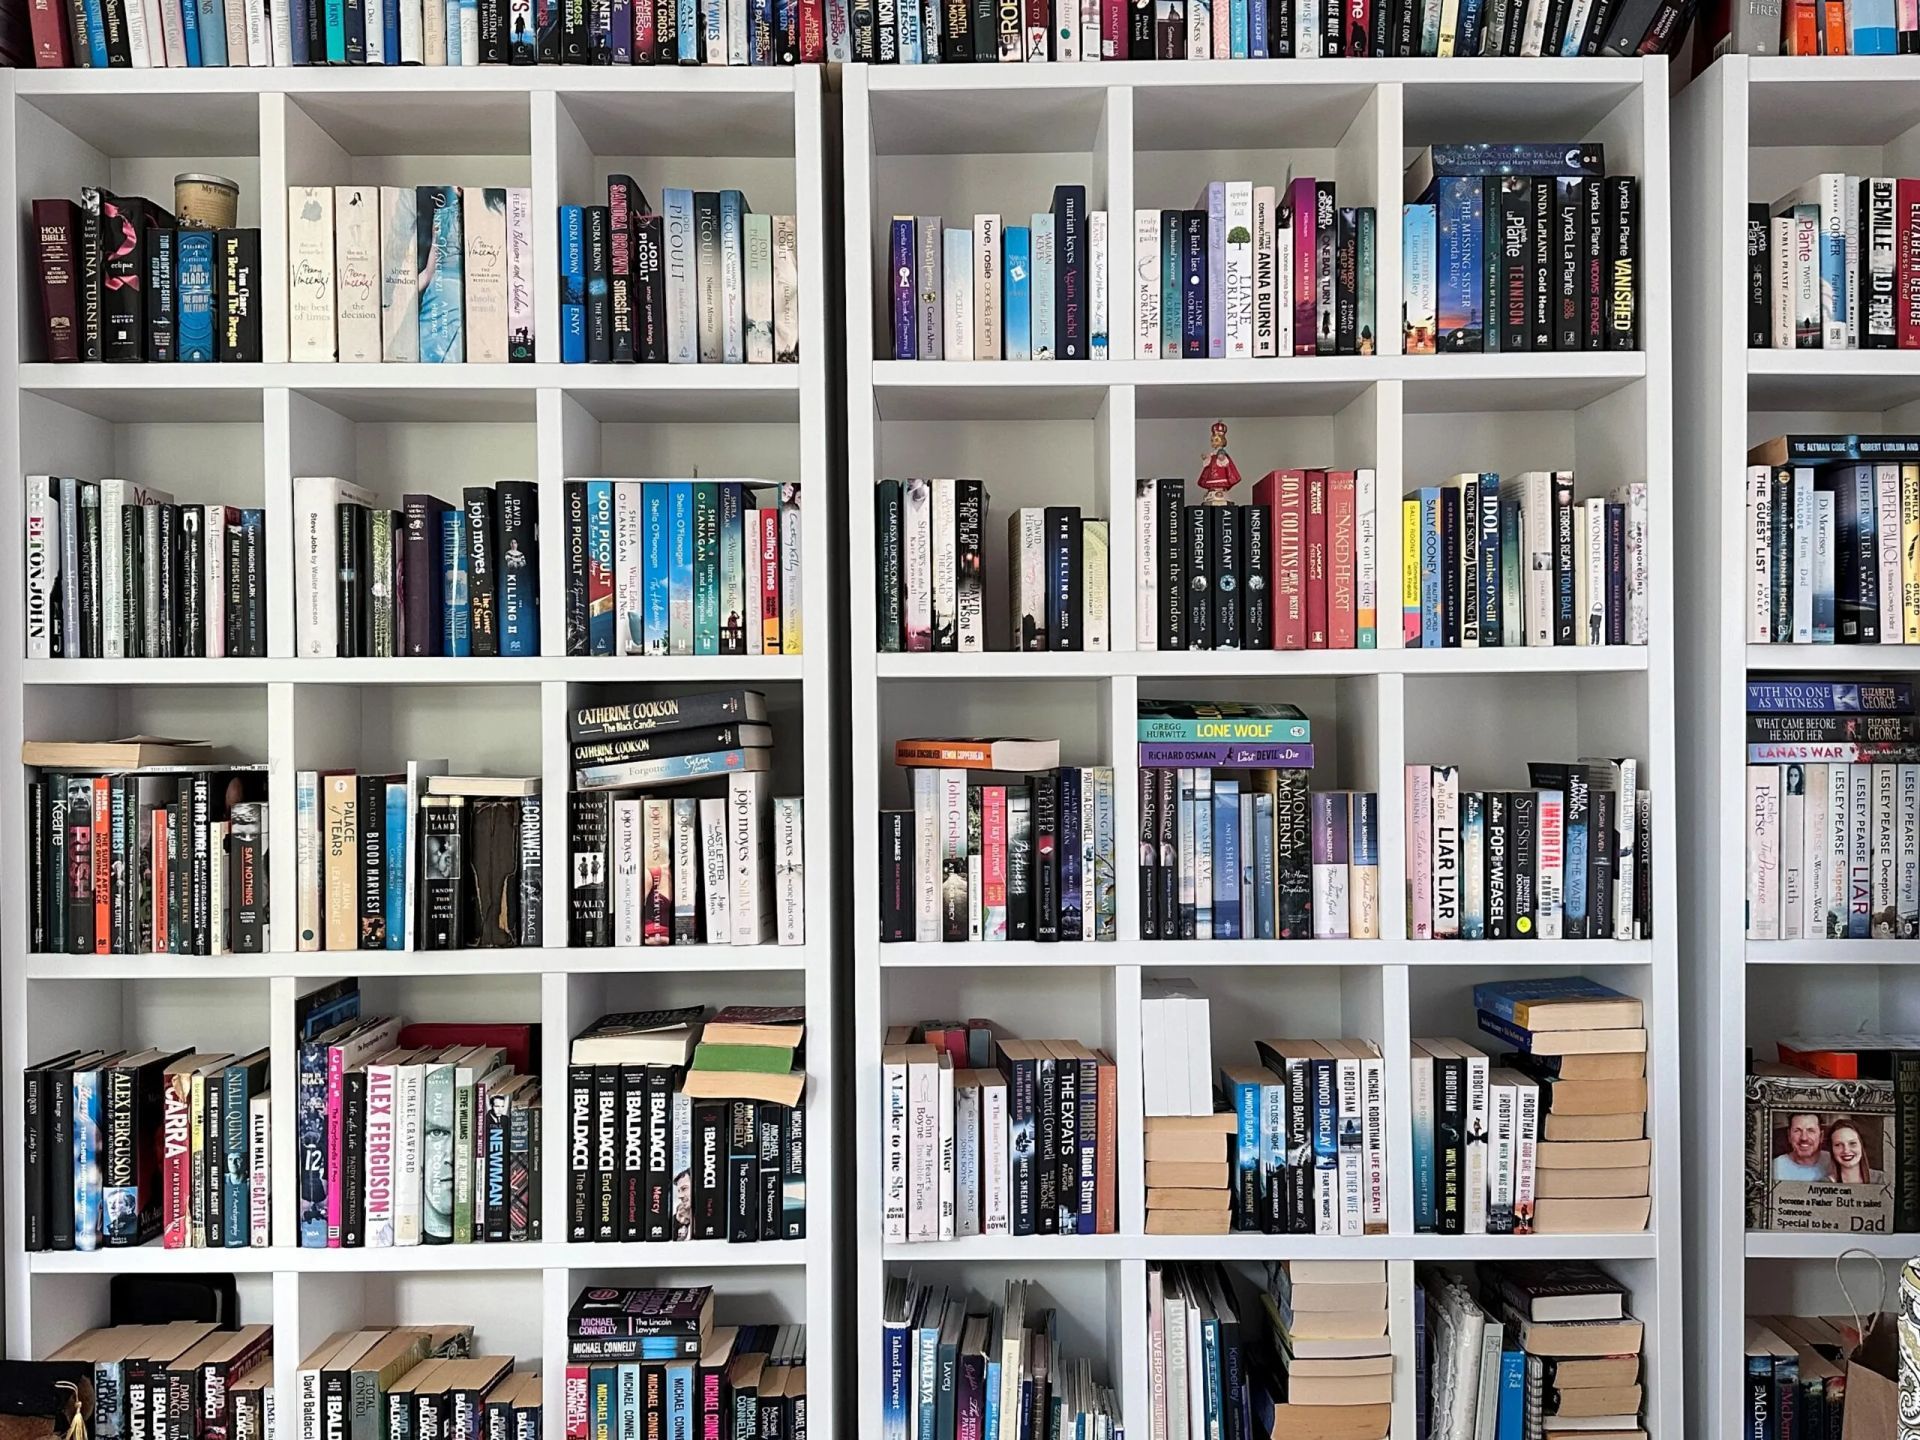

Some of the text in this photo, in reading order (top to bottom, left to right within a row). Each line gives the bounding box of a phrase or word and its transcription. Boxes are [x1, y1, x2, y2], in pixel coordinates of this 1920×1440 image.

[658, 18, 667, 43] CROSS
[709, 15, 719, 40] WIVES
[951, 7, 959, 38] MONTH
[1654, 6, 1671, 34] DOWNING
[1659, 9, 1679, 39] SAMANTHA
[1750, 4, 1779, 17] FIRES
[754, 11, 763, 61] PATTERSON
[762, 21, 770, 49] JAMES
[862, 26, 872, 57] PRIVATE
[41, 226, 66, 234] HOLY
[41, 234, 66, 242] BIBLE
[670, 205, 684, 281] PICOULT
[1799, 220, 1812, 262] Plante
[1874, 189, 1892, 251] DEMILLE
[639, 233, 648, 281] PICOULT
[649, 242, 657, 271] JODI
[1258, 253, 1270, 288] ANNA
[1614, 181, 1632, 331] Lynda La Plante VANISHED
[86, 241, 96, 341] TINA TURNER
[386, 275, 416, 285] abandon
[1227, 262, 1238, 339] MORIARTY
[1240, 276, 1251, 325] LIANE
[1510, 265, 1523, 325] TENNISON
[294, 303, 329, 311] the best
[342, 310, 376, 319] decision
[571, 308, 579, 335] ENVY
[1259, 294, 1271, 336] BURNS
[513, 499, 521, 526] DAVID
[571, 492, 582, 575] JODI PICOULT
[1281, 475, 1299, 567] JOAN COLLINS
[1756, 474, 1765, 574] THE GUEST LIST
[469, 501, 485, 574] jojo moyes
[599, 491, 610, 587] JODI PICOULT
[1194, 510, 1203, 570] DIVERGENT
[1222, 510, 1231, 569] ALLEGIANT
[1251, 510, 1260, 569] INSURGENT
[1426, 500, 1436, 574] SALLY ROONEY
[1467, 486, 1475, 622] PROPHET SONG PAUL LYNCH
[30, 517, 45, 638] ELTON JOHN
[970, 584, 979, 615] DAVID
[961, 592, 970, 630] HEWSON
[578, 700, 679, 726] CATHERINE COOKSON
[1750, 687, 1830, 698] WITH NO ONE
[1197, 725, 1231, 737] LONE
[1234, 725, 1273, 737] WOLF
[53, 800, 66, 846] Keane
[113, 789, 124, 854] AFTER EVEREST
[344, 801, 355, 843] PALACE
[429, 813, 457, 822] WALLY
[734, 788, 751, 862] jojo moyes
[1046, 789, 1054, 832] SEALED
[1293, 788, 1305, 848] MONICA
[332, 818, 342, 856] TEARS
[522, 806, 541, 870] CORNWELL
[1491, 827, 1504, 856] POP
[1853, 778, 1869, 915] LESLEY PEARSE LIAR
[245, 847, 253, 905] SAY NOTHING
[1439, 827, 1454, 919] LIAR LIAR
[1491, 868, 1504, 924] WEASEL
[226, 1073, 241, 1150] NIALL QUINN
[1062, 1073, 1074, 1155] THE EXPATS
[1319, 1065, 1330, 1147] LINWOOD BARCLAY
[1446, 1070, 1457, 1111] ROBOTHAM
[1473, 1070, 1483, 1111] ROBOTHAM
[115, 1073, 131, 1186] ALEX FERGUSON
[599, 1097, 614, 1170] BALDACCI
[626, 1096, 641, 1170] BALDACCI
[1080, 1062, 1096, 1214] COLIN FORBES Blood Storm
[1368, 1069, 1380, 1214] MICHAEL ROBOTHAM LIFE OR DEATH
[1499, 1098, 1510, 1140] ROBOTHAM
[1523, 1098, 1535, 1139] ROBOTHAM
[305, 1150, 322, 1171] 12
[370, 1073, 391, 1213] ALEX FERGUSON
[489, 1129, 503, 1205] NEWMAN
[603, 1174, 611, 1191] End
[1777, 1219, 1809, 1228] Special
[1812, 1220, 1821, 1228] to
[1822, 1220, 1831, 1228] be
[1851, 1215, 1885, 1231] Dad
[1527, 1280, 1617, 1294] PANDORA
[573, 1342, 636, 1354] MICHAEL CONNELLY
[579, 1326, 617, 1335] CONNELLY
[1173, 1301, 1183, 1373] LIVERPOOL
[922, 1339, 935, 1404] HIMALAYA
[1152, 1330, 1163, 1404] LIVERPOOL
[1229, 1346, 1240, 1402] Kimberley
[96, 1369, 107, 1424] BALDACCI
[108, 1380, 116, 1414] DAVID
[206, 1367, 215, 1419] BALDACCI
[215, 1377, 225, 1408] DAVID
[355, 1375, 365, 1417] CONTROL
[366, 1380, 374, 1410] TOTAL
[576, 1379, 586, 1426] MICHAEL
